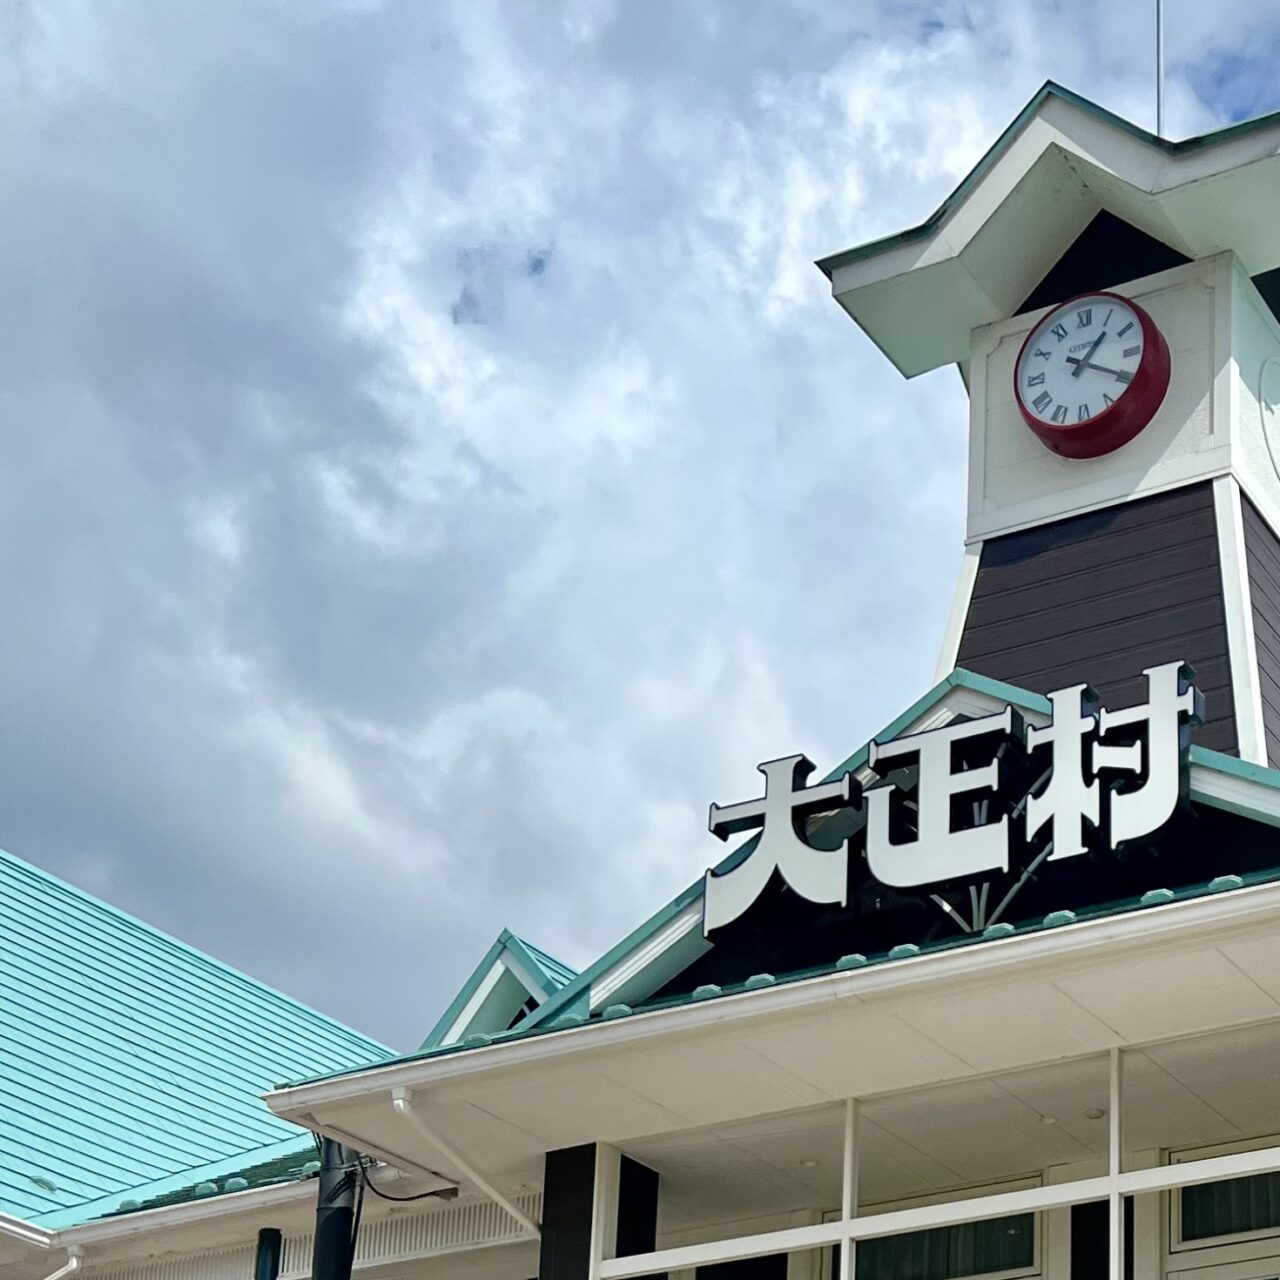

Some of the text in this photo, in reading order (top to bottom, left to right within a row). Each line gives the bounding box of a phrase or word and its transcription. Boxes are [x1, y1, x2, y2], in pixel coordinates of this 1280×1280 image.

[1051, 322, 1069, 343] XI
[1034, 347, 1052, 361] X
[703, 659, 1197, 937] 大正村
